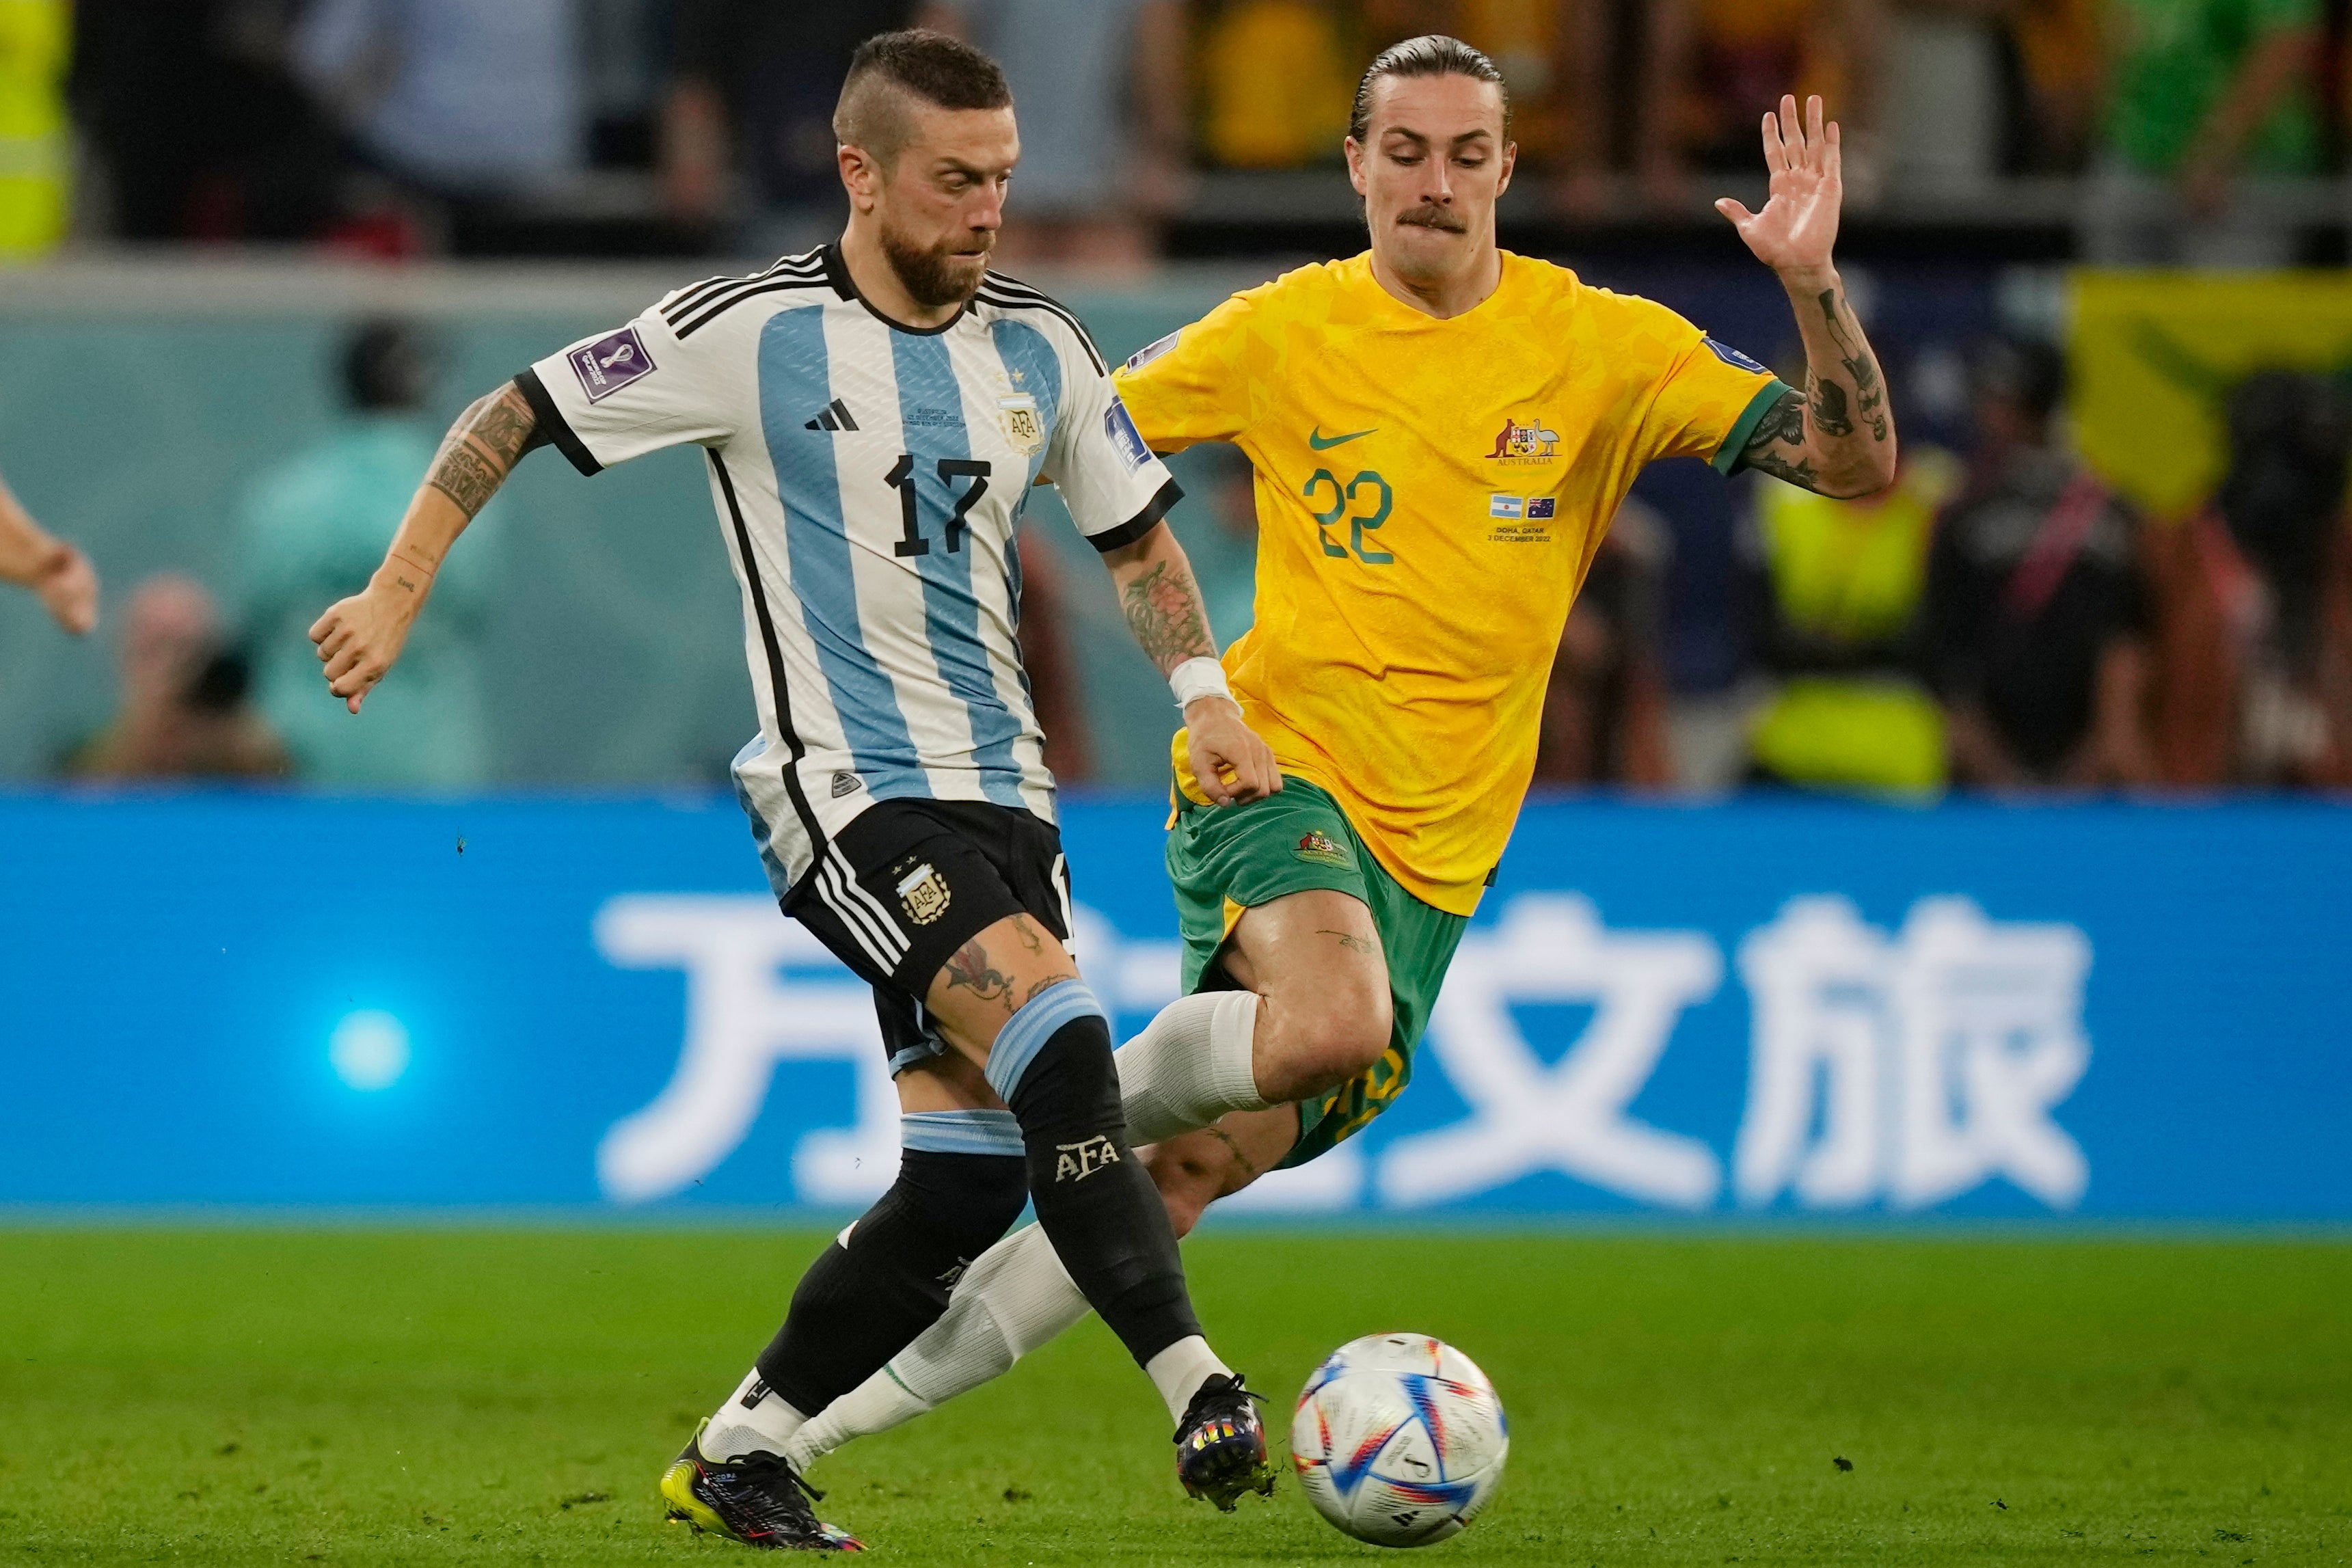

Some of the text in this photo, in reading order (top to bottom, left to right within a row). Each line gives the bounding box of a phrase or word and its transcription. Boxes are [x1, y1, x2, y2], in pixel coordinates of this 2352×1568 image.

[1011, 410, 1036, 438] AFA
[884, 455, 990, 557] 17
[1303, 468, 1394, 564] 22
[912, 881, 937, 910] AFA
[1055, 1134, 1120, 1182] AFA
